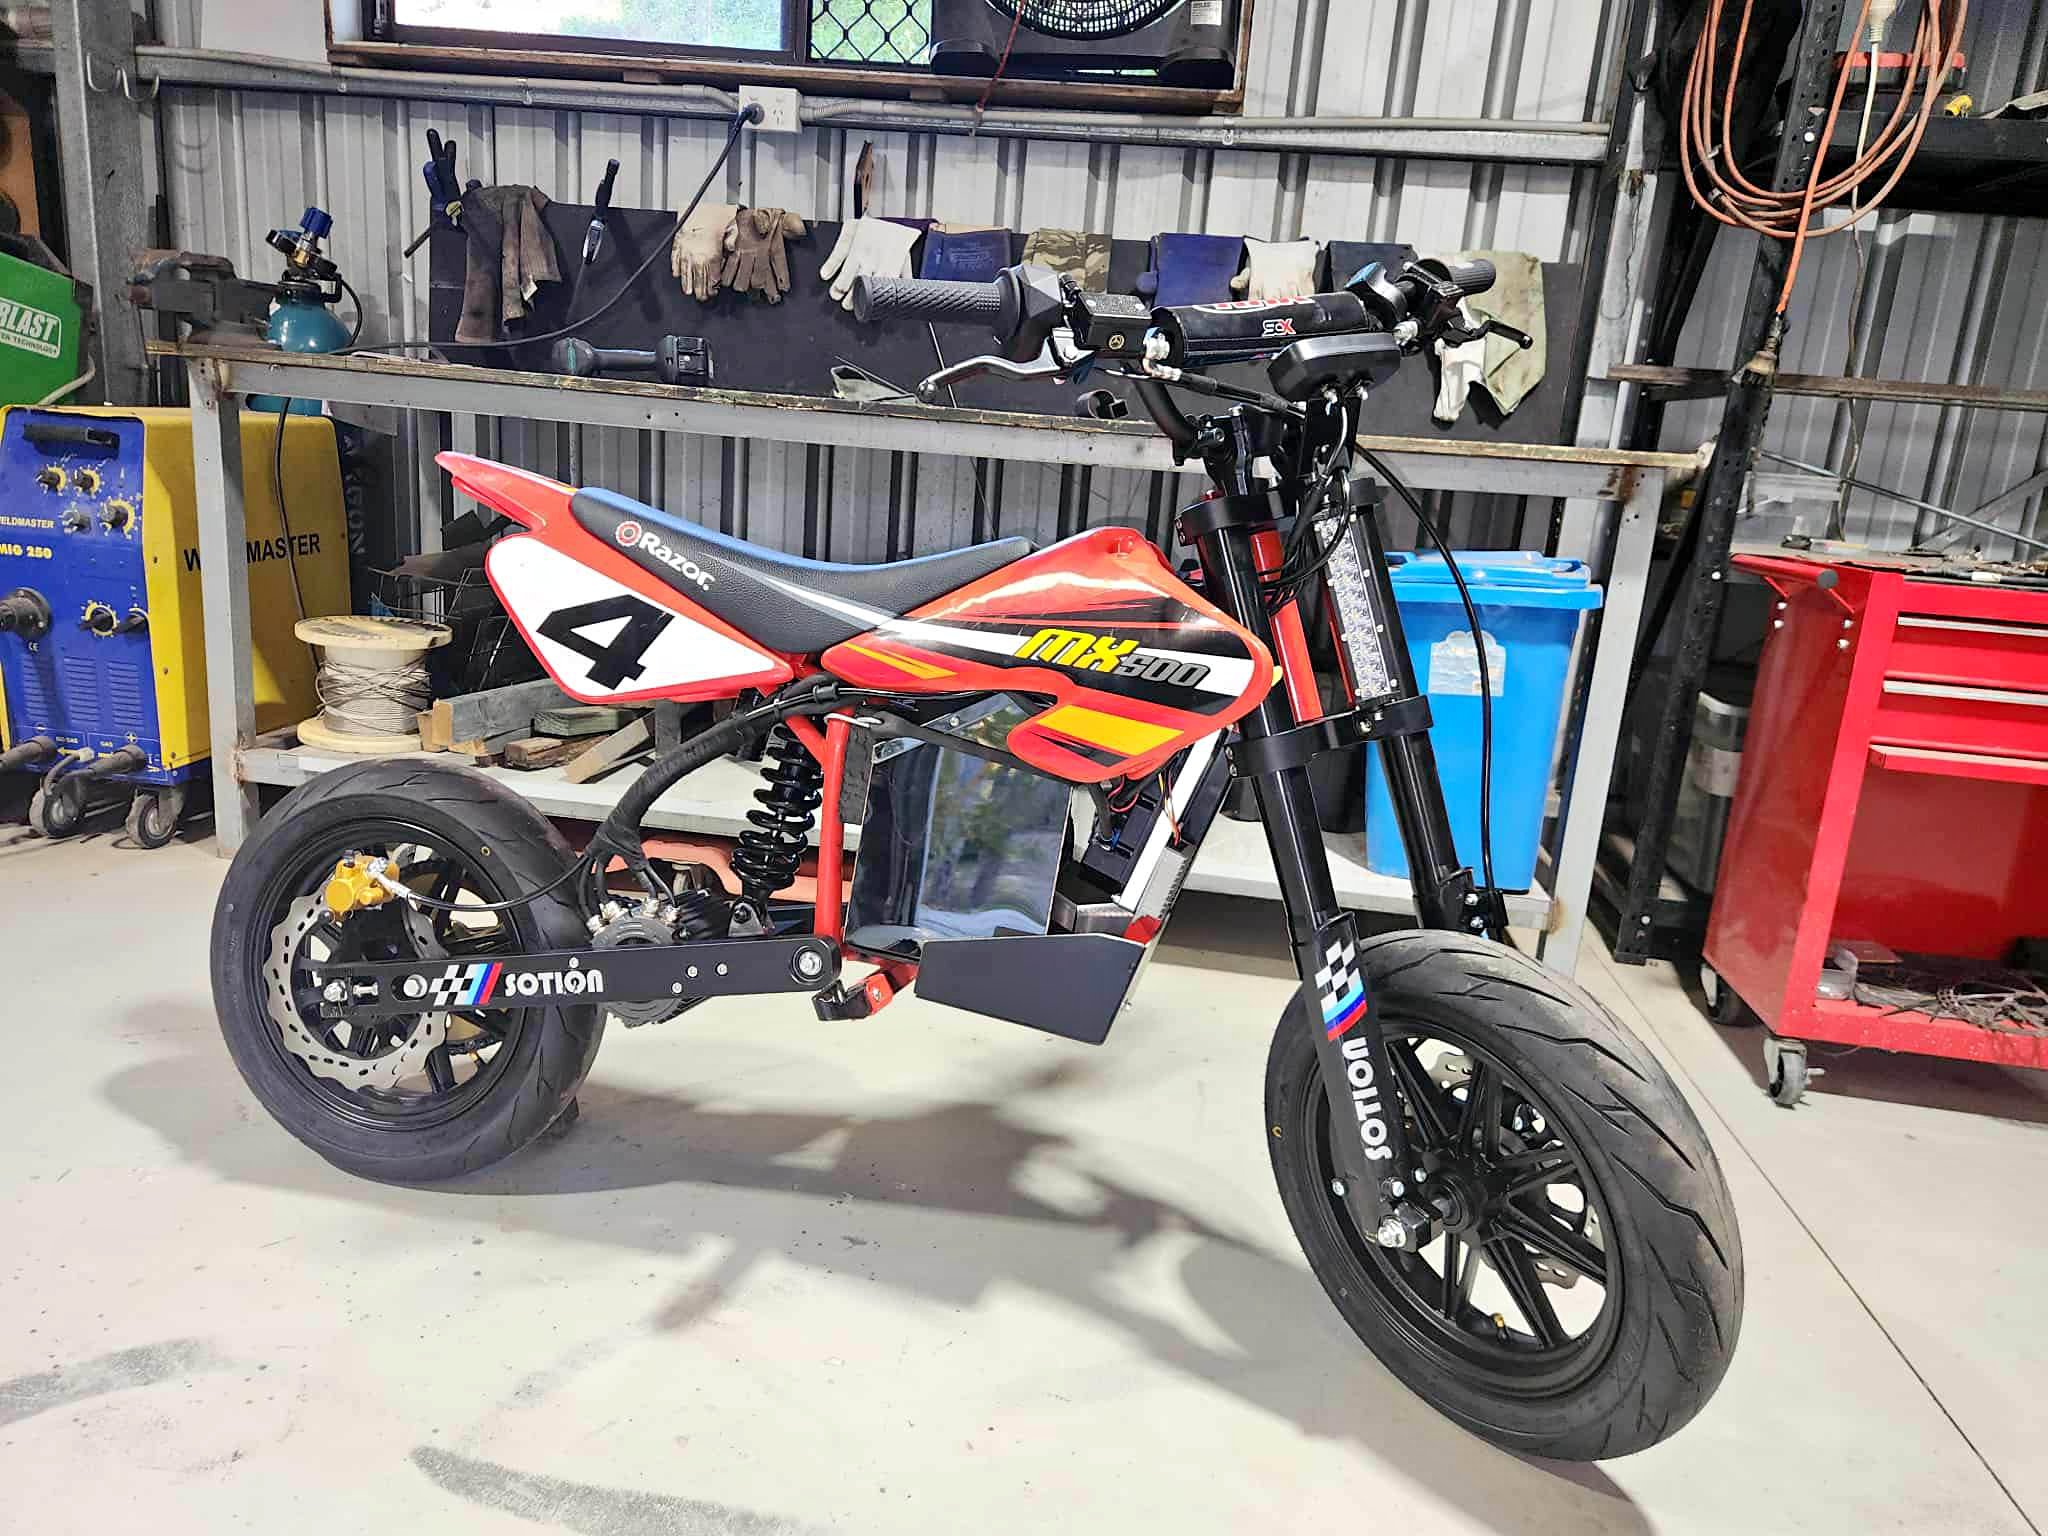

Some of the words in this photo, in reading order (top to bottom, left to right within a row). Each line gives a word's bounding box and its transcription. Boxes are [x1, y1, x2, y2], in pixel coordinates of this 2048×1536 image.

[0, 516, 55, 529] ELDMASTER
[26, 545, 53, 560] 250
[535, 594, 676, 690] 4
